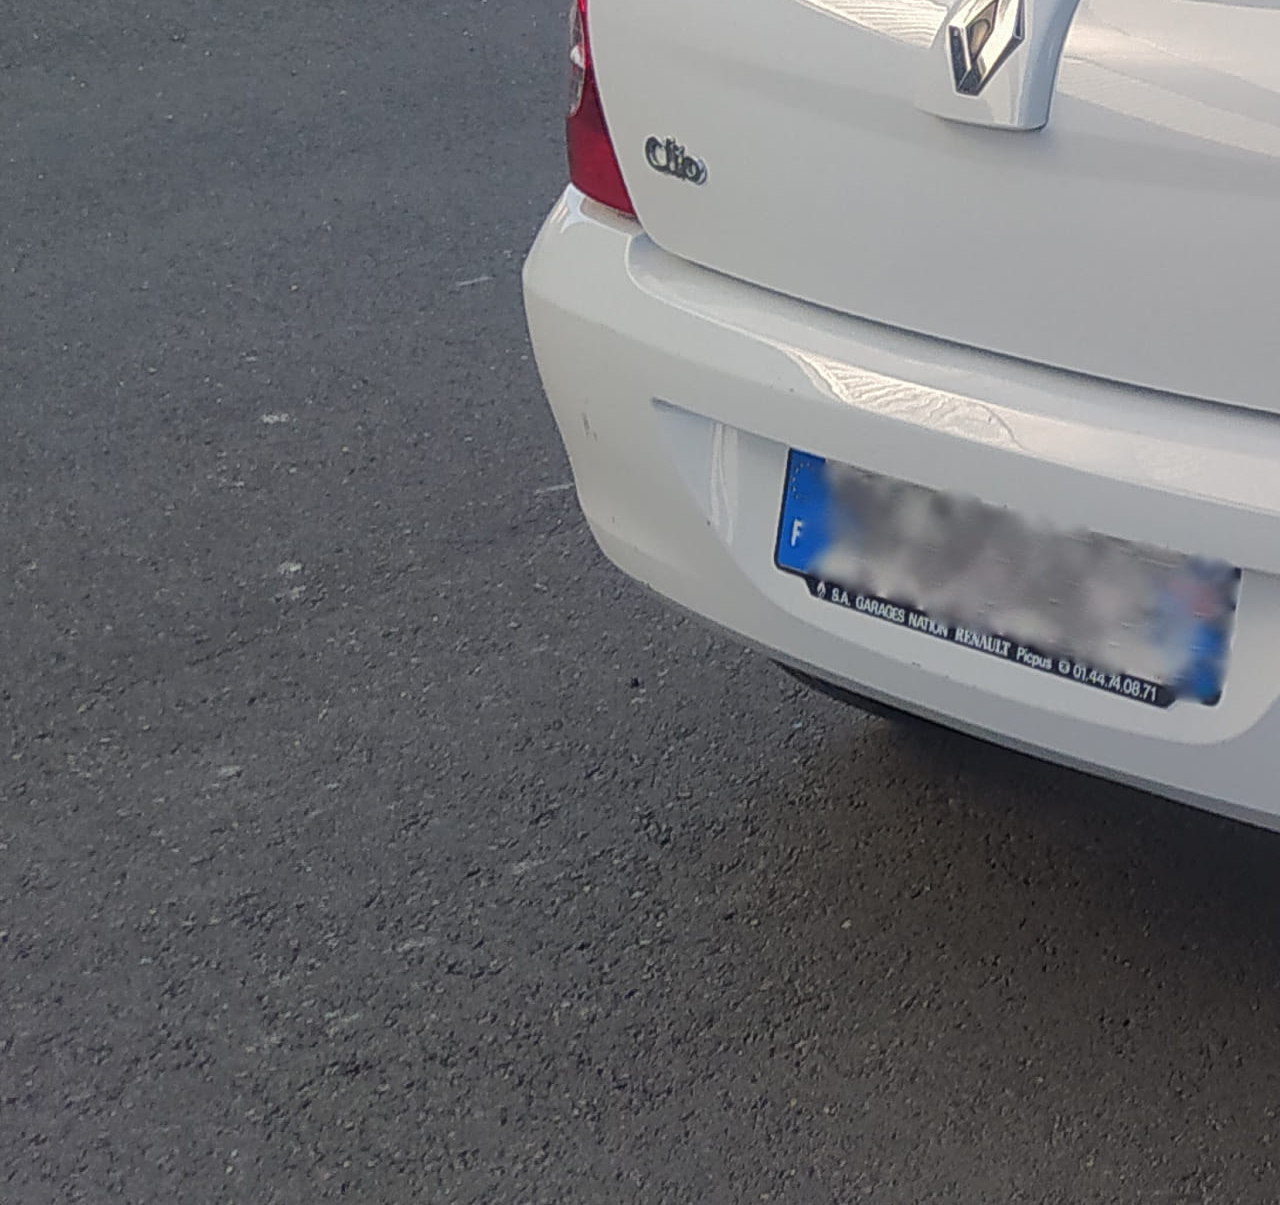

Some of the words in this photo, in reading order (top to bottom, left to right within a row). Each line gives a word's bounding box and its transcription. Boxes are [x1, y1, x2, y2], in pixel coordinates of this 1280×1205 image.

[645, 136, 708, 186] Clio
[856, 595, 905, 622] GARAGES
[908, 611, 947, 637] NATION
[955, 627, 1011, 657] RENAULT
[1016, 647, 1052, 670] Picpus
[1072, 663, 1157, 702] 01.44.74.08.71
